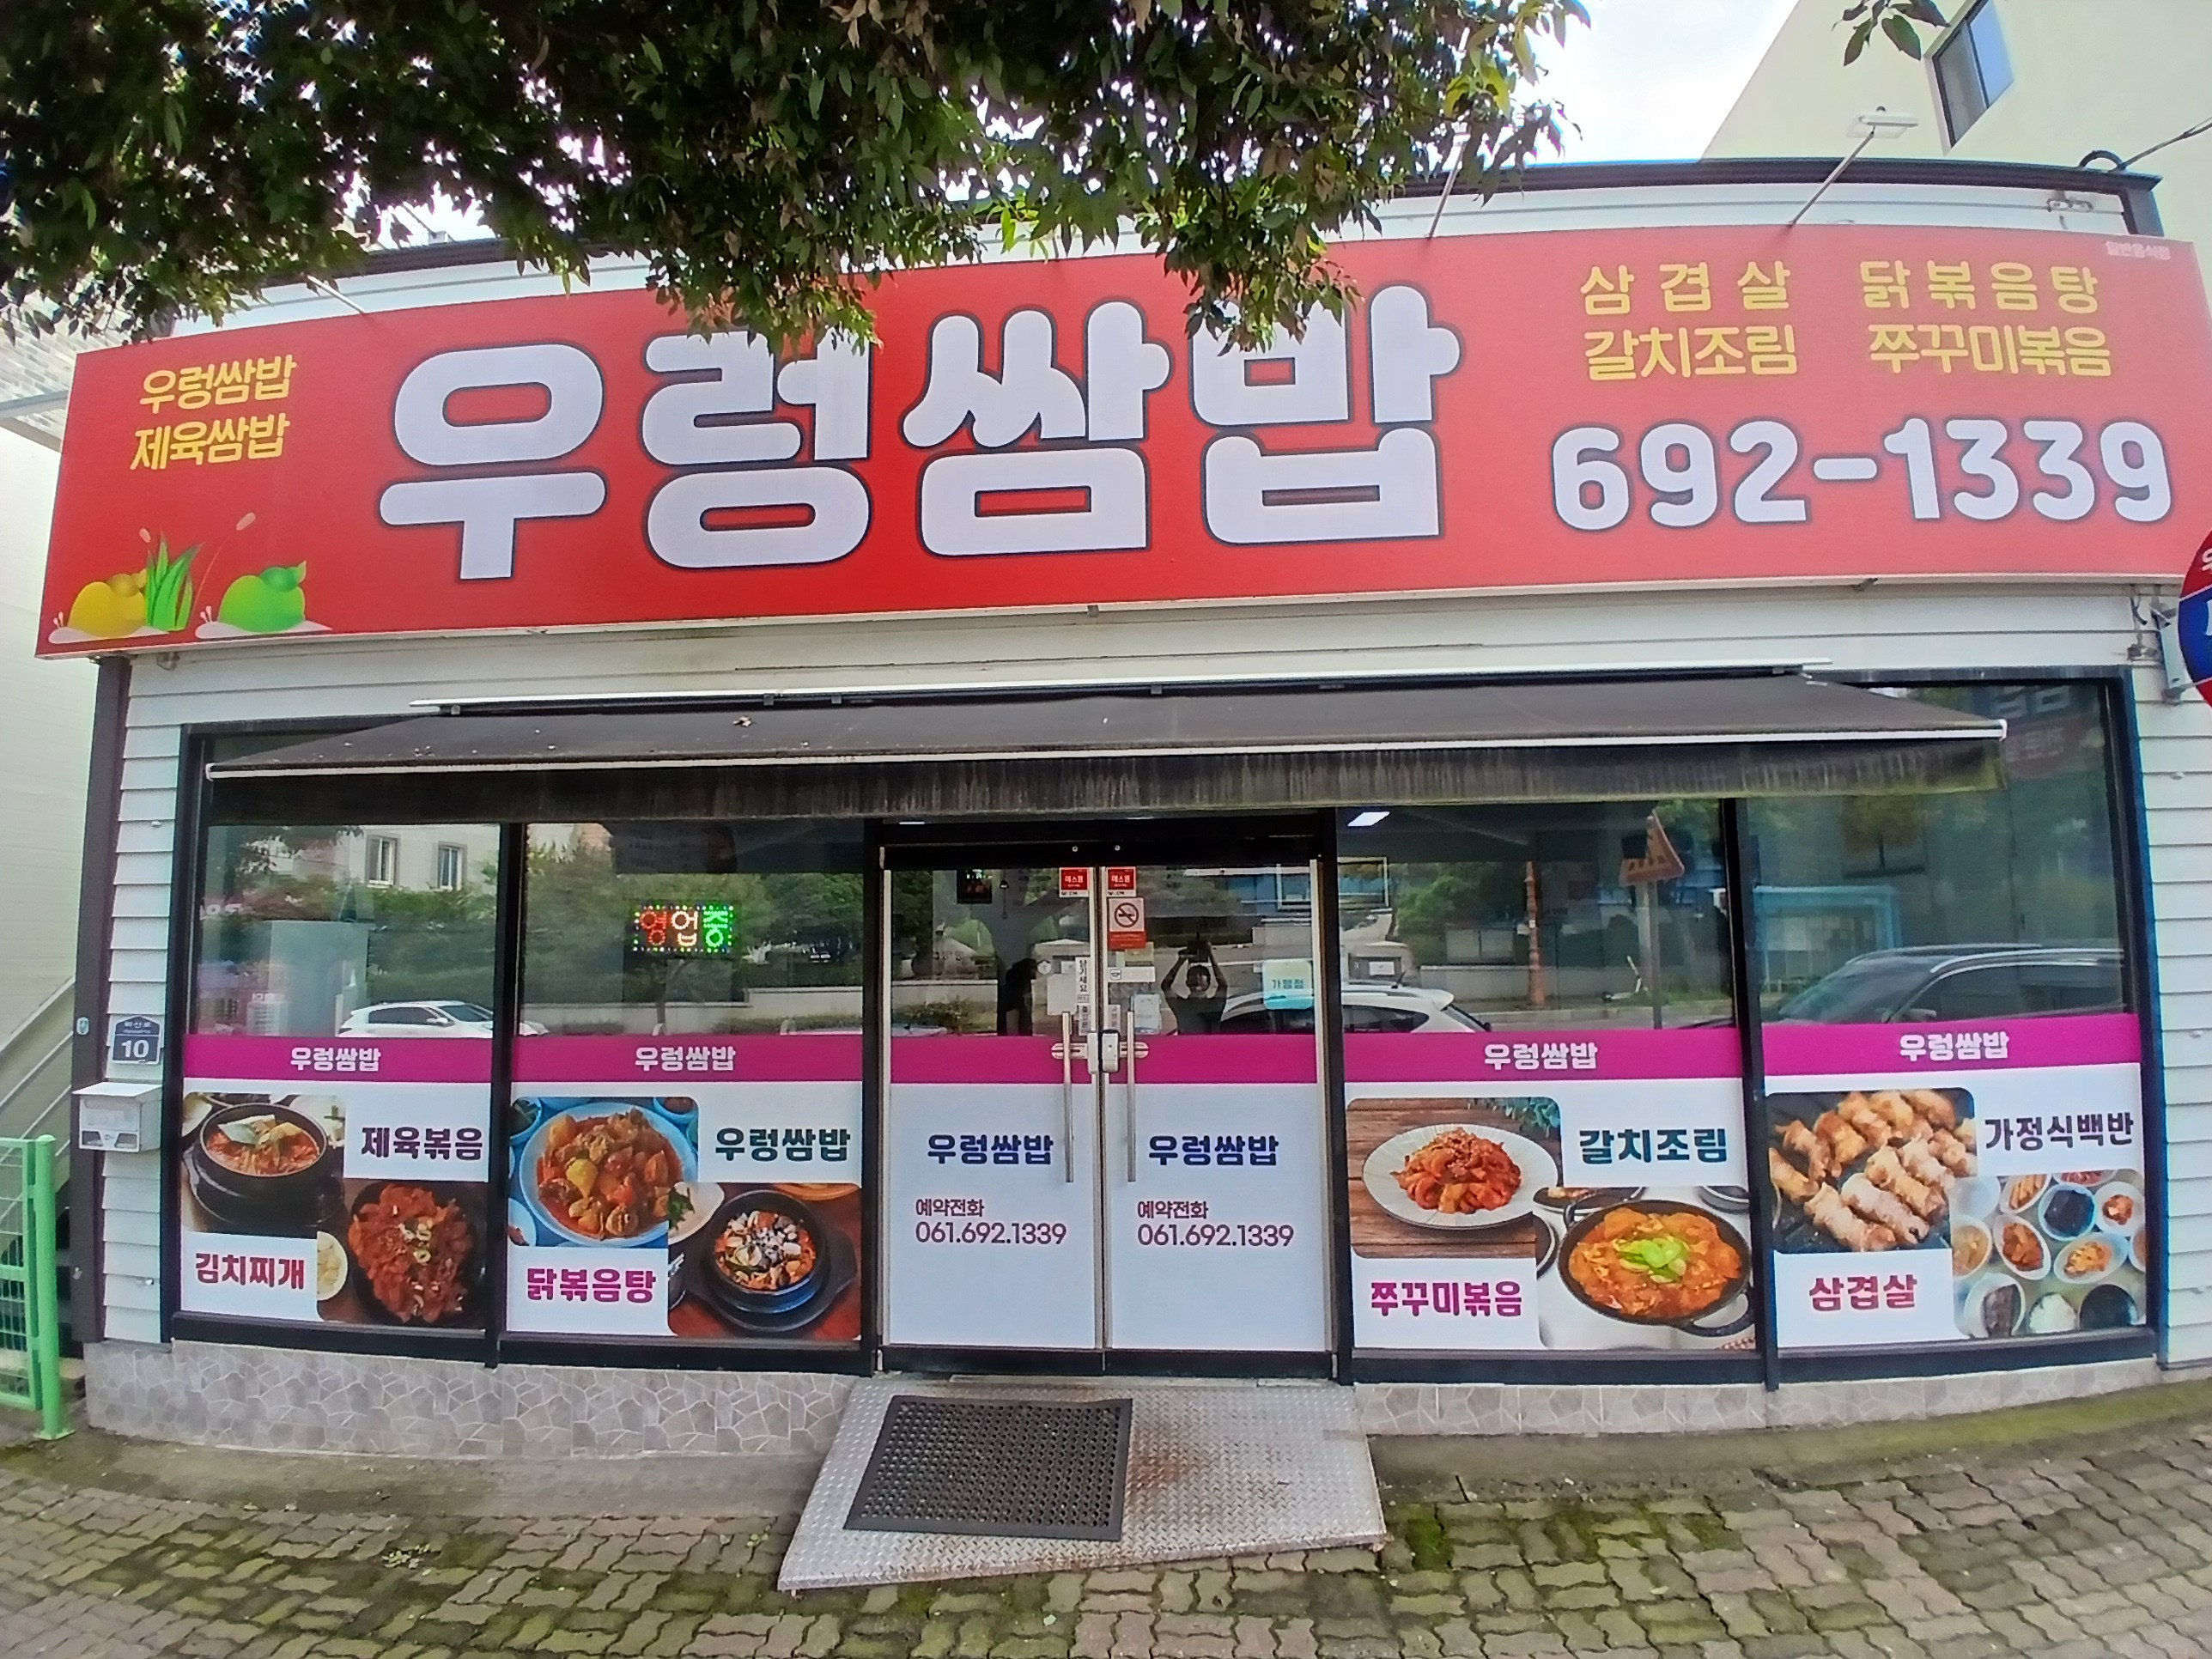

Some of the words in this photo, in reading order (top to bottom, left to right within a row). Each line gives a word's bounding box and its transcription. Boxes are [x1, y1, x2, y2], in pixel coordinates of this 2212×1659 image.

[1584, 325, 1797, 381] 갈치조림
[1869, 324, 2112, 377] 쭈꾸미볶음
[139, 354, 297, 414] 우렁쌈밥
[130, 413, 291, 471] 제육쌈밥
[379, 284, 1462, 580] 우렁쌈밥
[1550, 417, 2174, 532] 692-1339
[639, 910, 729, 948] 영업중
[121, 1039, 149, 1058] 10
[290, 1047, 381, 1072] 우렁쌈밥
[635, 1046, 736, 1072] 우렁쌈밥
[1484, 1042, 1598, 1070] 우렁쌈밥
[1899, 1031, 2009, 1061] 우렁쌈밥
[361, 1127, 483, 1161] 제육볶음
[715, 1127, 851, 1162] 우렁쌈밥
[927, 1133, 1054, 1165] 우렁쌈밥
[1579, 1128, 1728, 1165] 갈치조림
[1984, 1112, 2135, 1152] 가정식백반
[1148, 1134, 1279, 1166] 우렁쌈밥
[915, 1199, 985, 1218] 예약전화
[1137, 1200, 1209, 1219] 예약전화
[915, 1222, 1067, 1245] 061.692.1339
[1137, 1224, 1295, 1247] 061.692.1339
[195, 1253, 305, 1290] 김치찌개
[526, 1268, 656, 1304] 닭볶음탕
[1370, 1280, 1522, 1317] 쭈꾸미볶음
[1808, 1273, 1918, 1312] 삼겹살
